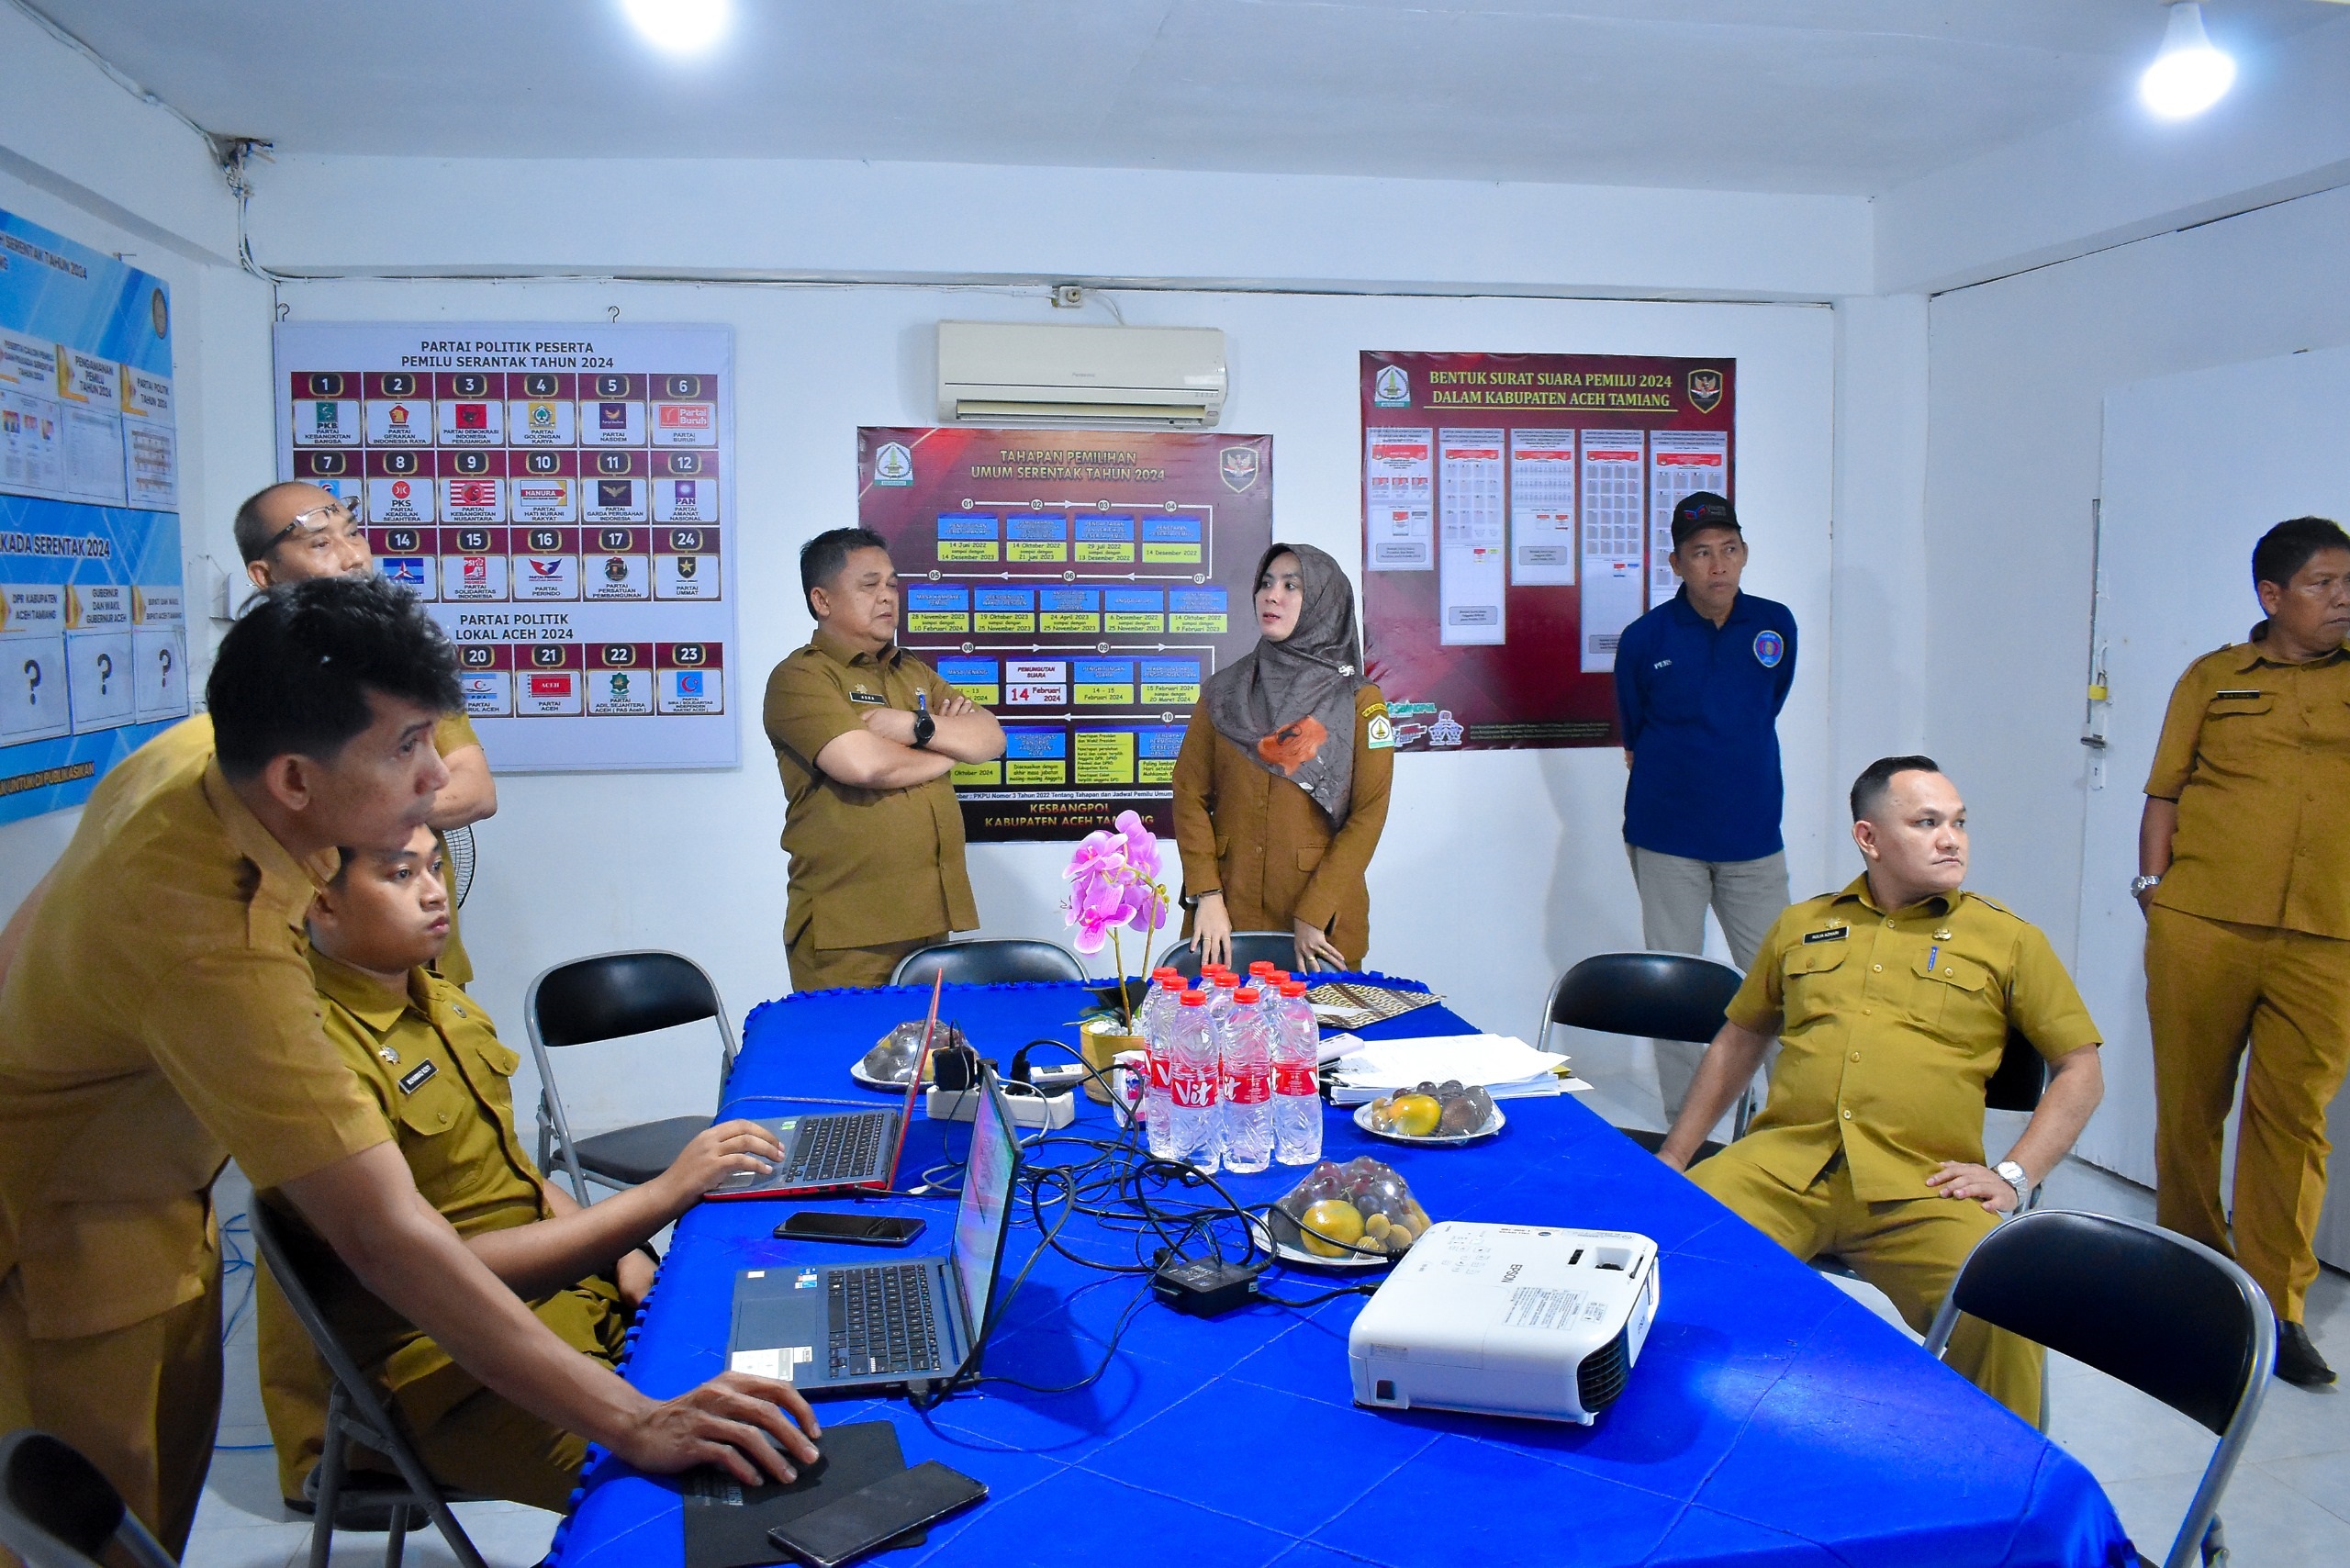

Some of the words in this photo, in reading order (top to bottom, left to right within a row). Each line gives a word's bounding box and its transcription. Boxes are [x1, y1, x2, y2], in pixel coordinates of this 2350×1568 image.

[421, 341, 472, 353] PARTAI
[476, 341, 531, 353] POLITIK
[535, 342, 594, 353] PESERTA
[401, 355, 452, 367] PEMILU
[456, 356, 527, 368] SERANTAK
[531, 356, 576, 368] TAHUN
[581, 357, 614, 368] 2024
[321, 378, 330, 390] 1
[393, 378, 403, 391] 2
[465, 378, 475, 391] 3
[536, 379, 547, 392] 4
[608, 379, 618, 392] 5
[1429, 371, 1487, 385] BENTUK
[1490, 372, 1534, 386] SURAT
[1537, 373, 1583, 386] SUARA
[1585, 374, 1636, 387] PEMILU
[1639, 375, 1673, 387] 2024
[79, 380, 99, 396] TAHUN
[678, 379, 688, 393] 6
[1433, 390, 1482, 404] DALAM
[1485, 391, 1566, 405] KABUPATEN
[1569, 392, 1606, 405] ACEH
[1608, 393, 1670, 407] TAMIANG
[679, 408, 708, 418] Partai
[679, 416, 708, 425] Buruh
[323, 456, 332, 469] 7
[396, 456, 405, 468] 8
[467, 456, 476, 468] 9
[535, 456, 551, 468] 10
[607, 456, 619, 468] 11
[677, 456, 692, 469] 12
[1000, 450, 1063, 464] TAHAPAN
[1067, 451, 1136, 465] PEMILIHAN
[970, 466, 1013, 479] UMUM
[1017, 466, 1082, 480] SERENTAK
[1086, 467, 1132, 481] TAHUN
[1134, 468, 1165, 481] 2024
[395, 533, 410, 546] 14
[466, 533, 482, 546] 15
[537, 533, 552, 546] 16
[609, 533, 623, 545] 17
[677, 533, 695, 545] 24
[34, 535, 85, 556] SERENTAK
[86, 538, 110, 557] 2024
[26, 594, 58, 604] KABUPATEN
[92, 588, 118, 598] GUBERNUR
[92, 600, 105, 610] DAN
[105, 601, 120, 610] WAKIL
[86, 614, 114, 624] GUBERNUR
[114, 613, 127, 623] ACEH
[460, 614, 509, 626] PARTAI
[514, 614, 569, 625] POLITIK
[455, 629, 498, 641] LOKAL
[502, 629, 538, 640] ACEH
[541, 628, 574, 640] 2024
[610, 648, 628, 661] 22
[680, 647, 698, 660] 23
[963, 644, 973, 652] 08
[1099, 644, 1108, 652] 09
[468, 649, 487, 663] 20
[542, 649, 556, 662] 21
[158, 648, 172, 688] ?
[1653, 659, 1673, 669] PERS
[96, 653, 113, 695] ?
[23, 659, 42, 706] ?
[1011, 688, 1030, 701] 14
[1030, 803, 1109, 813] KESBANGPOL
[985, 816, 1058, 827] KABUPATEN
[1061, 815, 1093, 826] ACEH
[1174, 1081, 1214, 1106] Vit
[1501, 1263, 1523, 1282] EPSON
